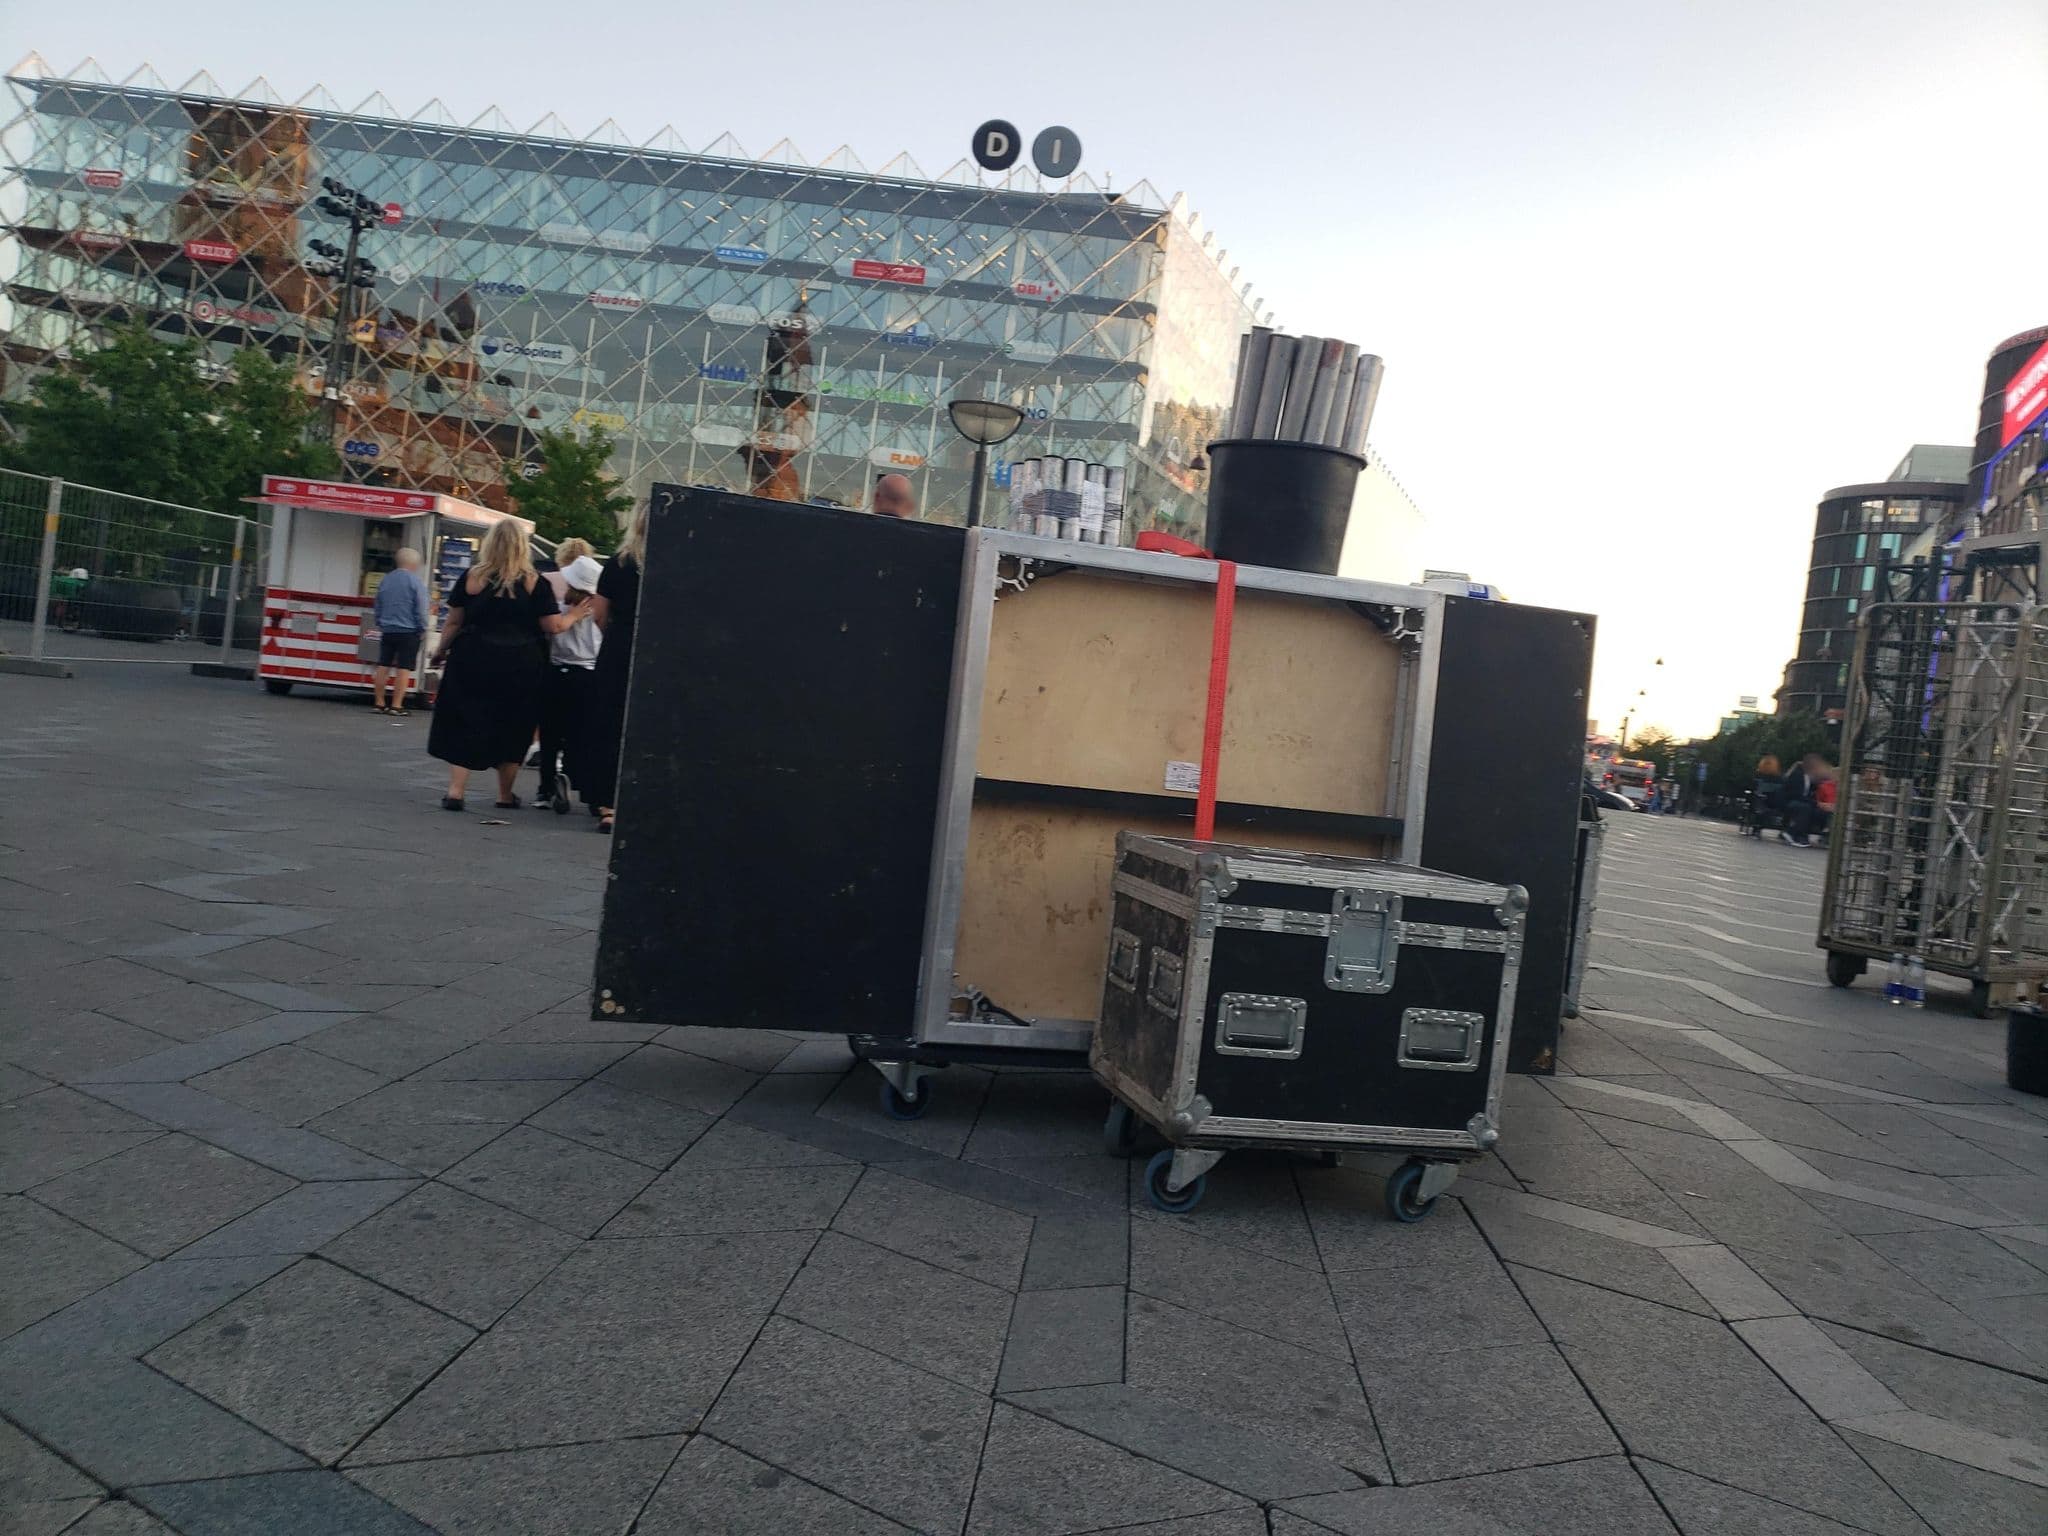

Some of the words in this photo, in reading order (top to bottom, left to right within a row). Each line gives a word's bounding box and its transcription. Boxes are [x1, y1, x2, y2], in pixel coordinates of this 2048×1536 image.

[986, 131, 1009, 157] D
[1052, 138, 1062, 164] I
[1016, 283, 1042, 296] DBI
